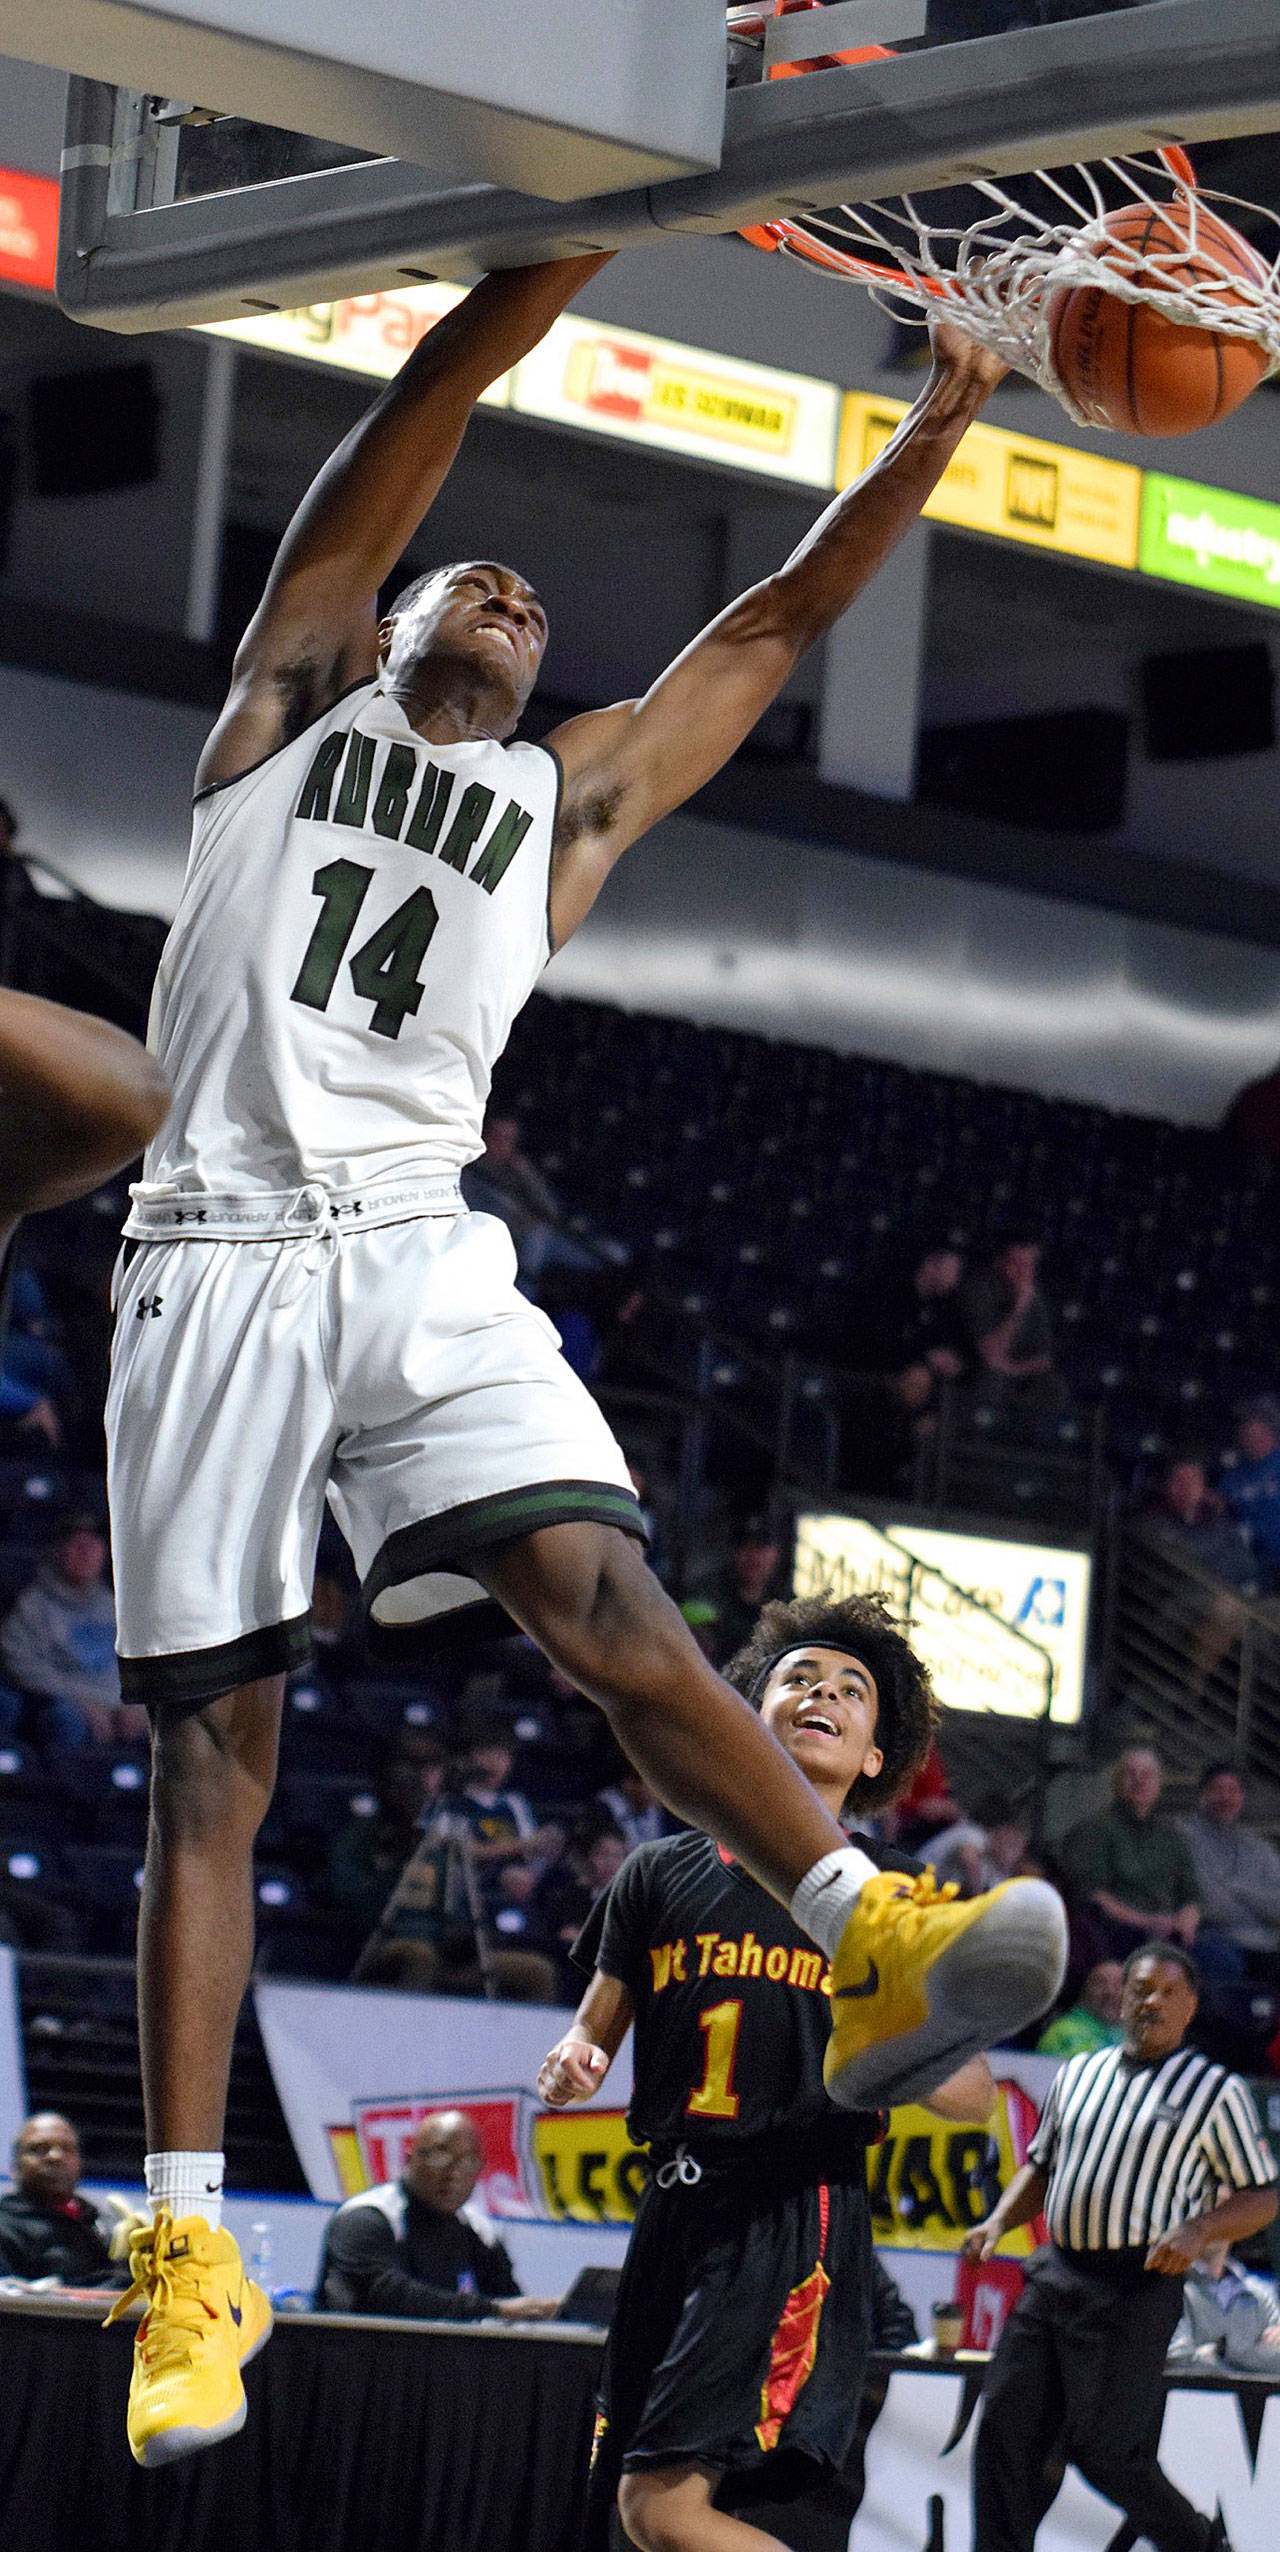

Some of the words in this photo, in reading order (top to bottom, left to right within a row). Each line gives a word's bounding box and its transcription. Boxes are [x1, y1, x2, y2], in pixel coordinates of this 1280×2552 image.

[295, 728, 534, 895] AUBURN
[289, 858, 440, 1041] 14
[685, 1998, 744, 2119] 1
